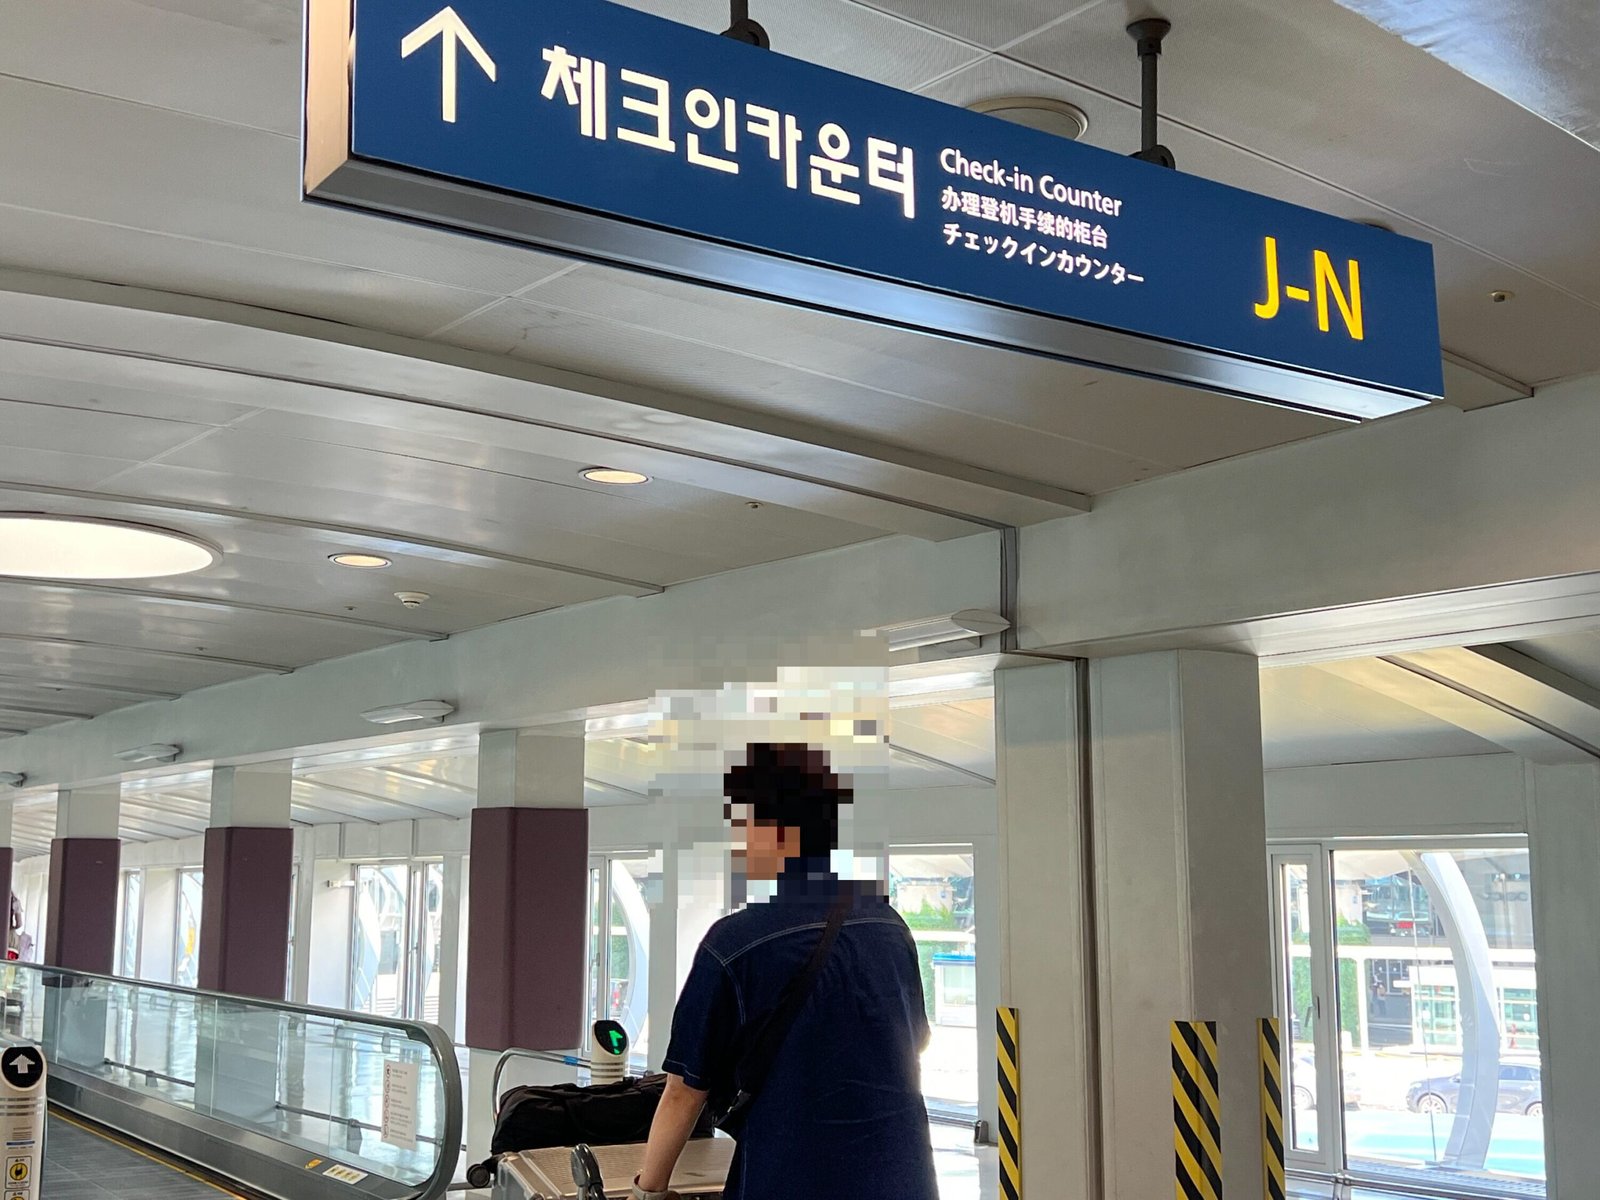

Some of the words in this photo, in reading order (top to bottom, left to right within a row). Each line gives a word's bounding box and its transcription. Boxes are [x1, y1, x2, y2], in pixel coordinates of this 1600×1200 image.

[540, 44, 916, 219] 체크인카운터
[939, 147, 1034, 194] Check-in
[1039, 174, 1123, 217] Counter
[941, 186, 1109, 250] 办理登机手续的柜台
[942, 223, 1145, 285] チェックインカウンター
[1253, 236, 1364, 341] J-N
